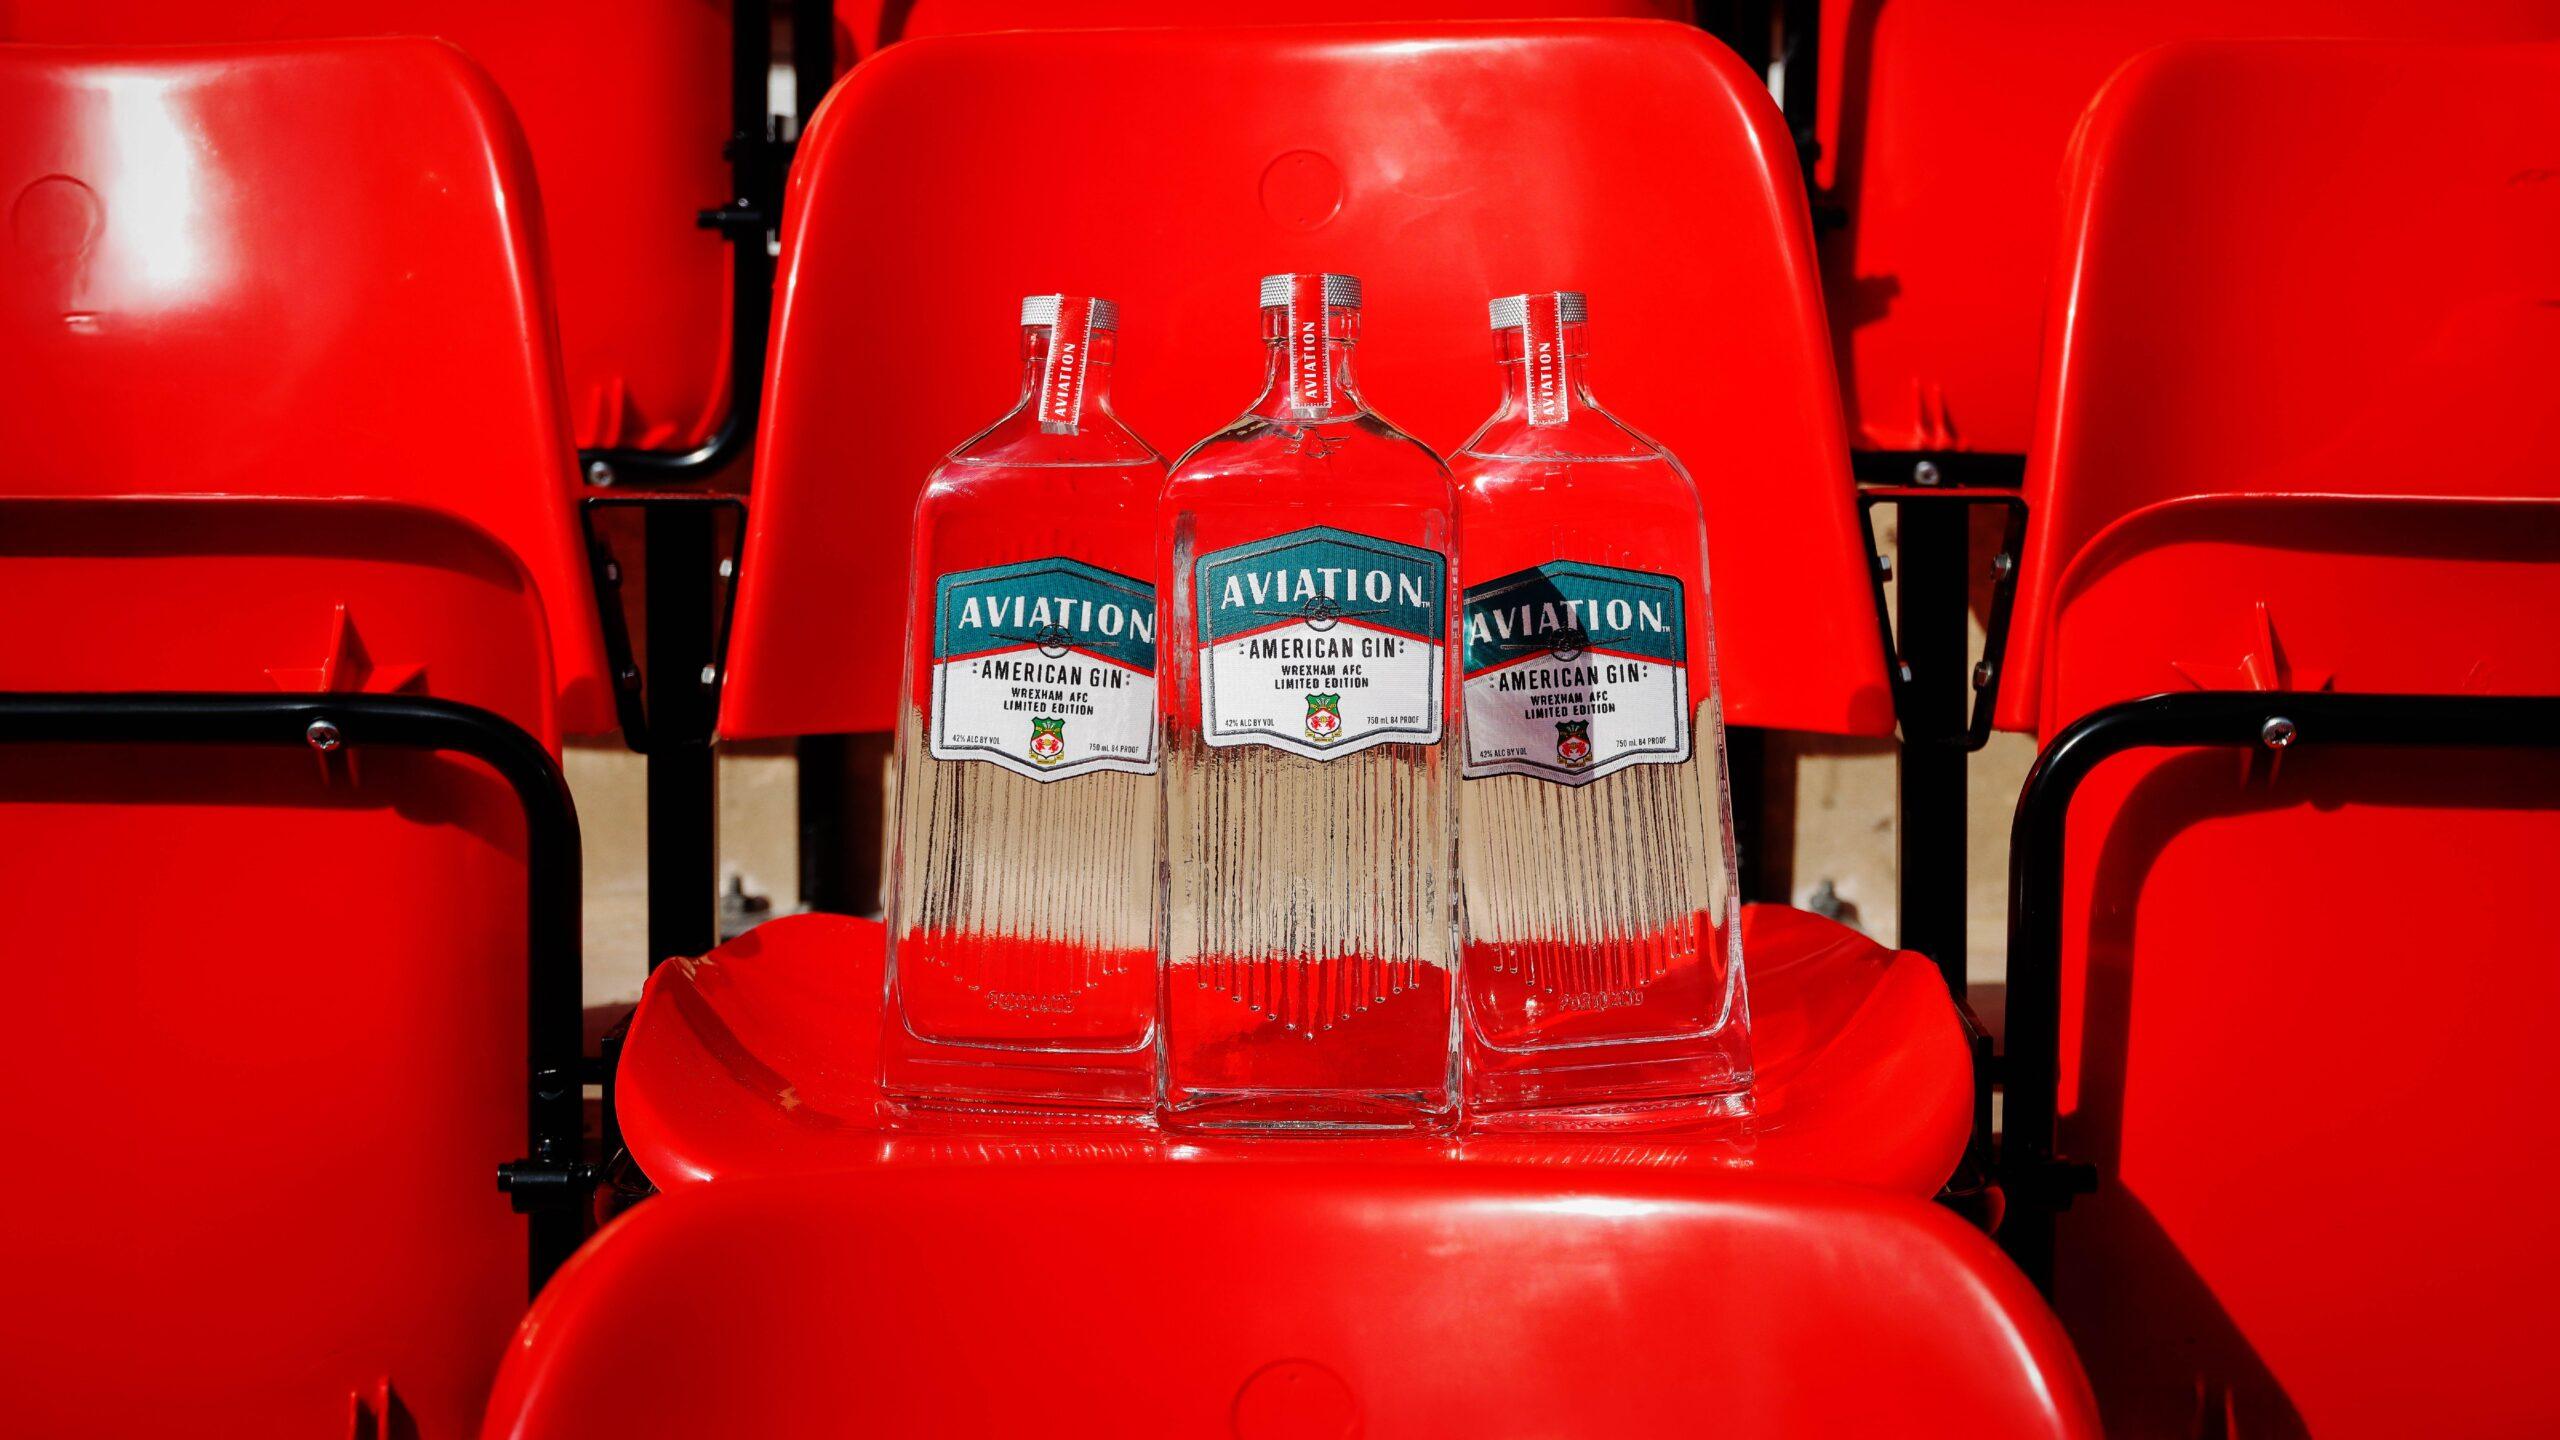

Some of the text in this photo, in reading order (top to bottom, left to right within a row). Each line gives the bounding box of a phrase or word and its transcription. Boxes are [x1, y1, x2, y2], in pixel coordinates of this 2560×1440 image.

[1302, 321, 1318, 399] AVIATION
[1054, 342, 1076, 417] AVIATION
[1539, 342, 1555, 416] AVIATION
[1221, 568, 1422, 609] AVIATION
[958, 595, 1153, 644] AVIATION
[1469, 599, 1662, 646] AVIATION
[1249, 637, 1395, 660] AMERICAN GIN
[981, 659, 1122, 689] AMERICAN GIN
[1281, 664, 1362, 676] WREXHAM AFC
[1499, 662, 1639, 691] AMERICAN GIN
[1274, 677, 1369, 690] LIMITED EDITION
[1011, 687, 1088, 703] WREXHAM AFC
[1530, 690, 1608, 706] WREXHAM AFC
[1003, 699, 1094, 715] LIMITED EDITION
[1525, 703, 1616, 720] LIMITED EDITION
[1225, 718, 1275, 727] 42% ALC BY VOL
[1367, 716, 1379, 725] 750
[1400, 715, 1420, 724] PROOF
[952, 734, 1000, 745] 42% ALC BY VOL
[1616, 739, 1628, 748] 750
[1647, 735, 1667, 745] PROOF
[1089, 743, 1100, 751] 750
[1120, 745, 1139, 754] PROOF
[1480, 747, 1527, 758] 42% ALC BY VOL
